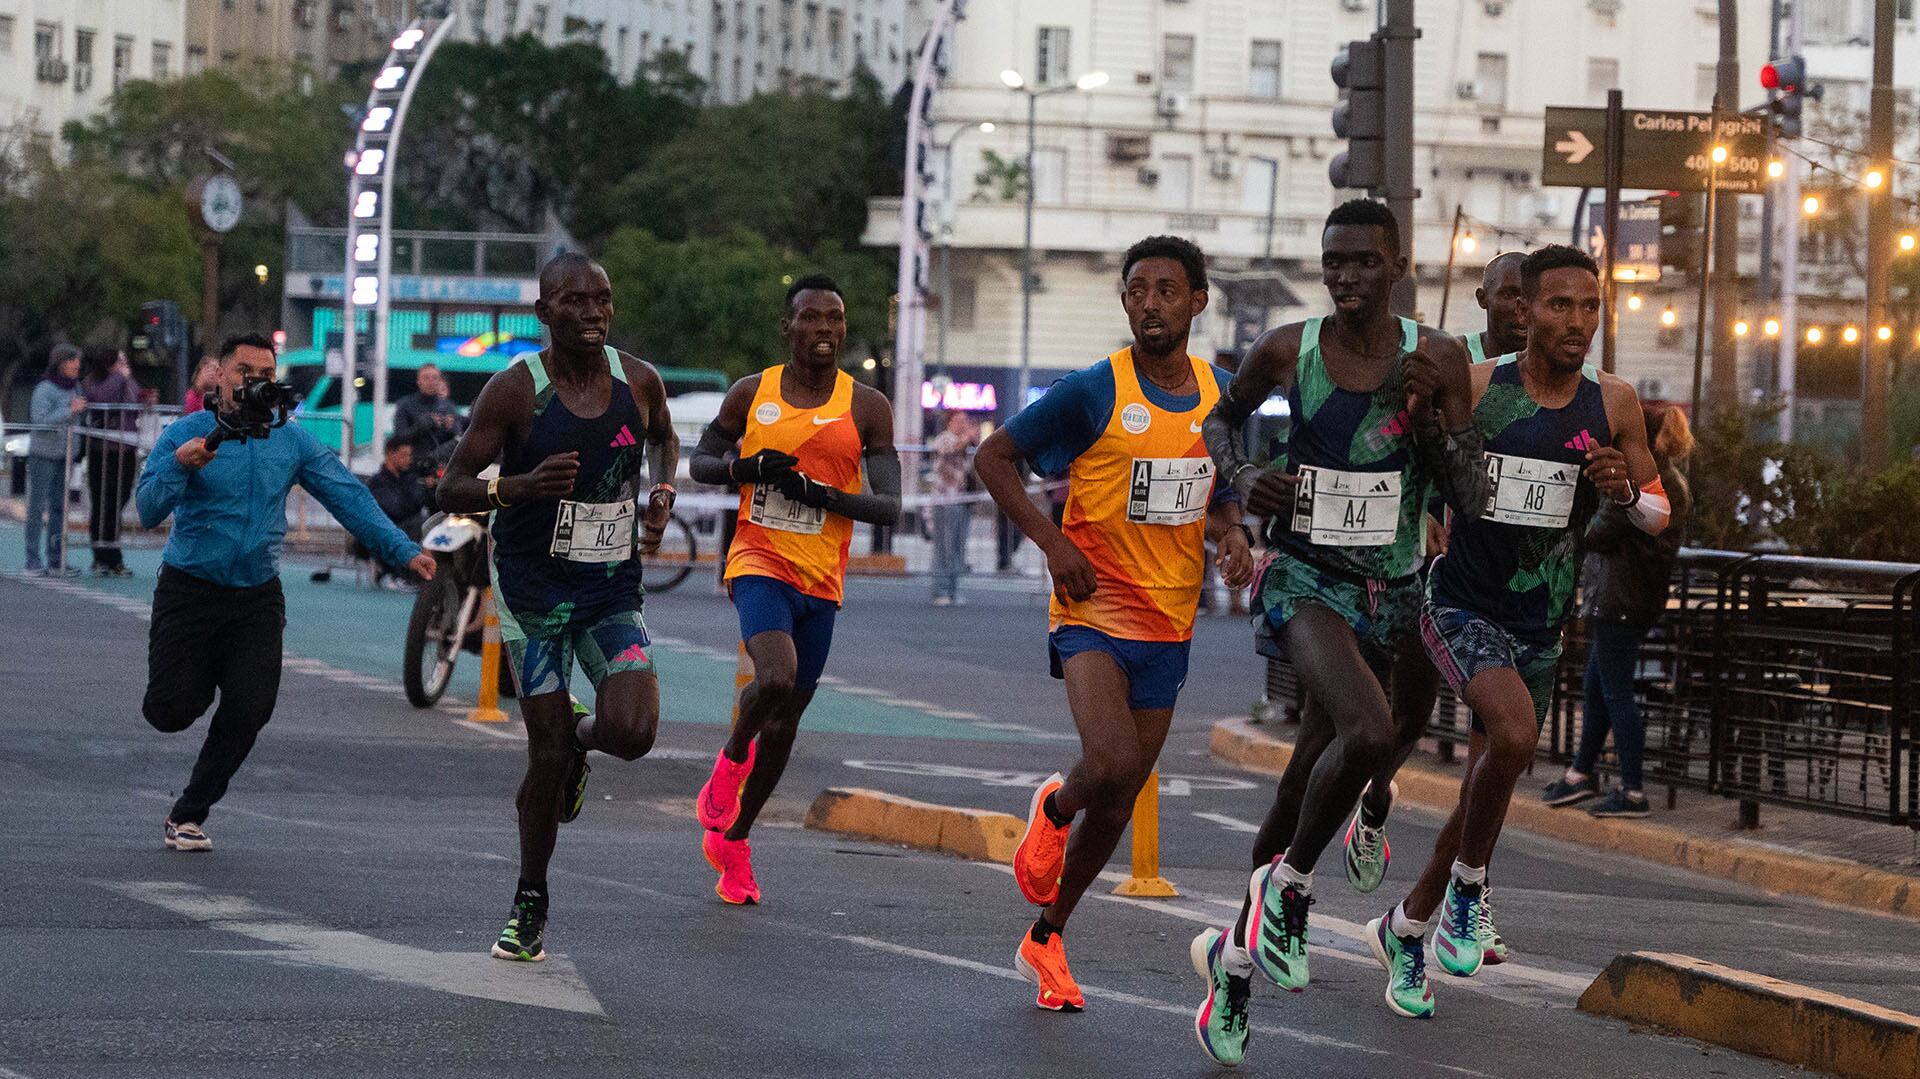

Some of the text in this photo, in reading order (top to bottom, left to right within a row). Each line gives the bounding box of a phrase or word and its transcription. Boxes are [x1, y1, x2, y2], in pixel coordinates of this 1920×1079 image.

[1633, 113, 1761, 137] Carlos Pelegrini
[1729, 157, 1759, 173] 500
[1133, 462, 1149, 487] A
[1299, 470, 1313, 500] A
[1175, 482, 1193, 509] A7
[1523, 483, 1546, 511] A8
[560, 504, 573, 528] A
[1342, 499, 1367, 530] A4
[595, 522, 616, 547] A2
